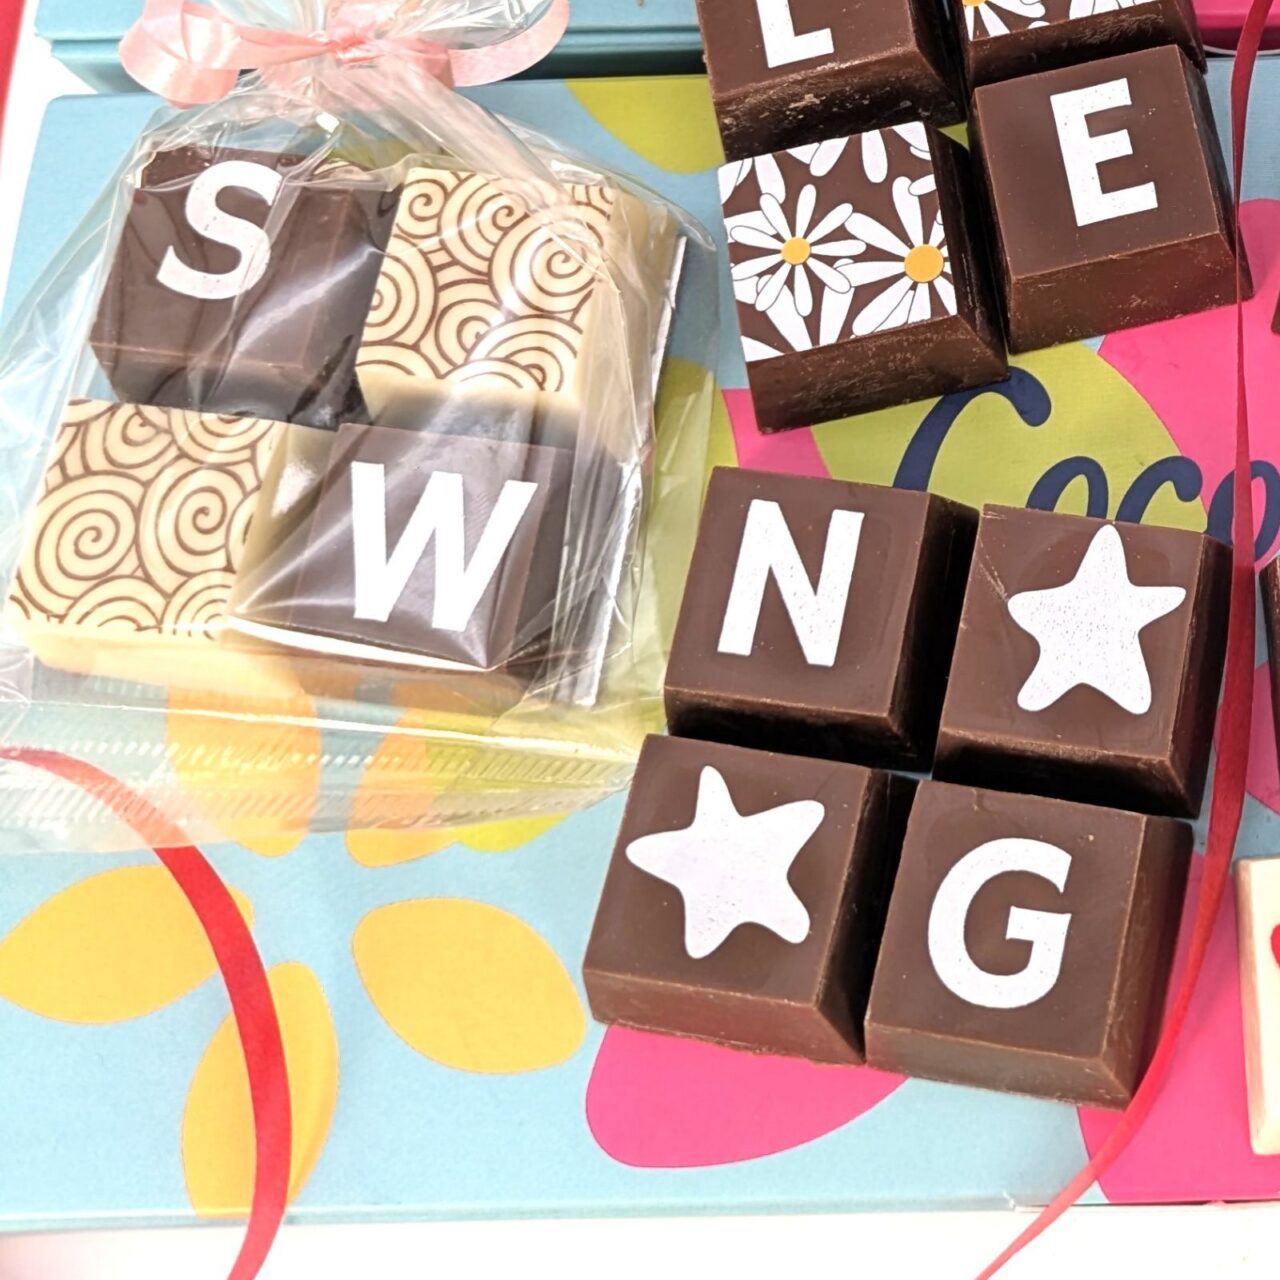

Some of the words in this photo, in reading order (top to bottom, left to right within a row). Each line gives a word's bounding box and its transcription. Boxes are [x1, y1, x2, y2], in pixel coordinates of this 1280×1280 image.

[154, 161, 282, 301] S
[1051, 78, 1157, 226] E
[347, 462, 538, 631] W
[718, 499, 864, 667] N
[928, 838, 1071, 1008] G
